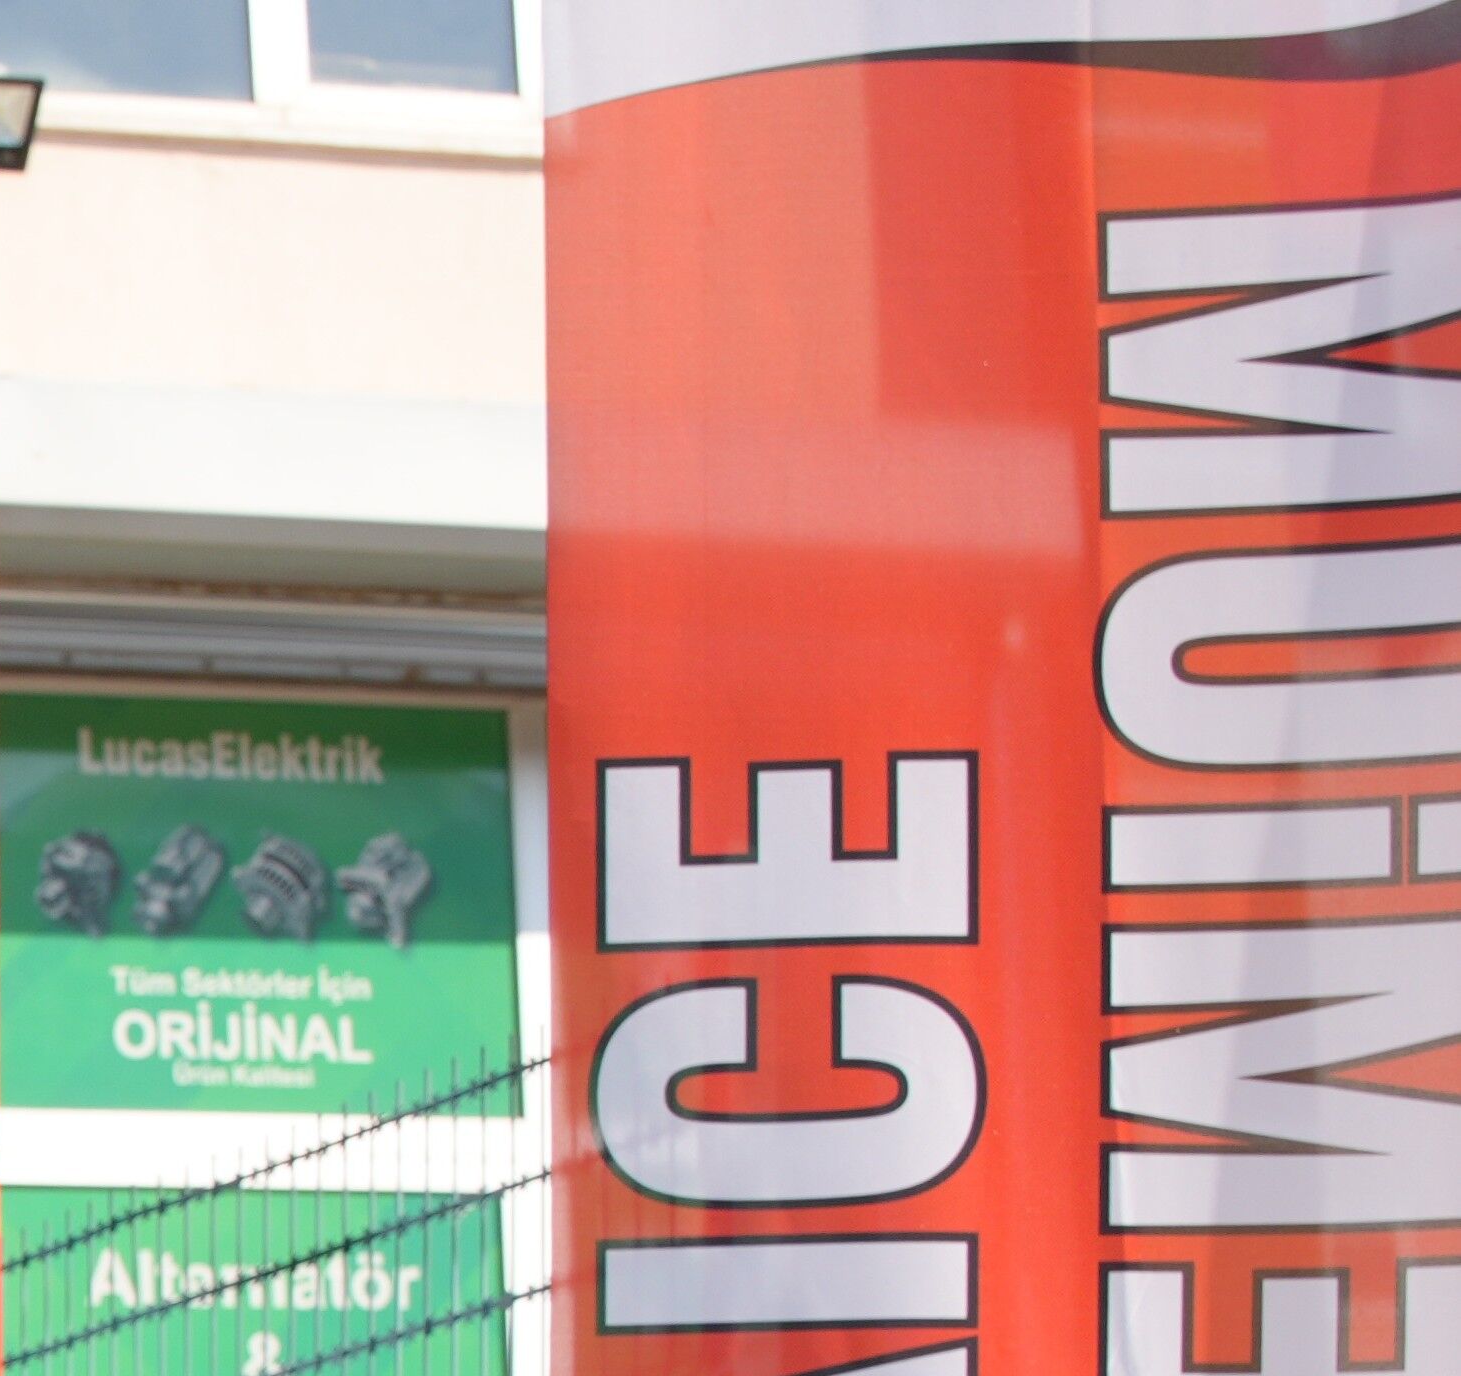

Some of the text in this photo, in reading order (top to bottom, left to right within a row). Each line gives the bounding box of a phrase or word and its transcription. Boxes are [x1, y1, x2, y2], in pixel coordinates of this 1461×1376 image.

[76, 725, 386, 783] LucasElektrik
[108, 964, 177, 996] Tüm
[182, 966, 314, 999] Sektörler
[111, 1000, 374, 1064] ORİJİNAL
[88, 1247, 423, 1312] Alternatör
